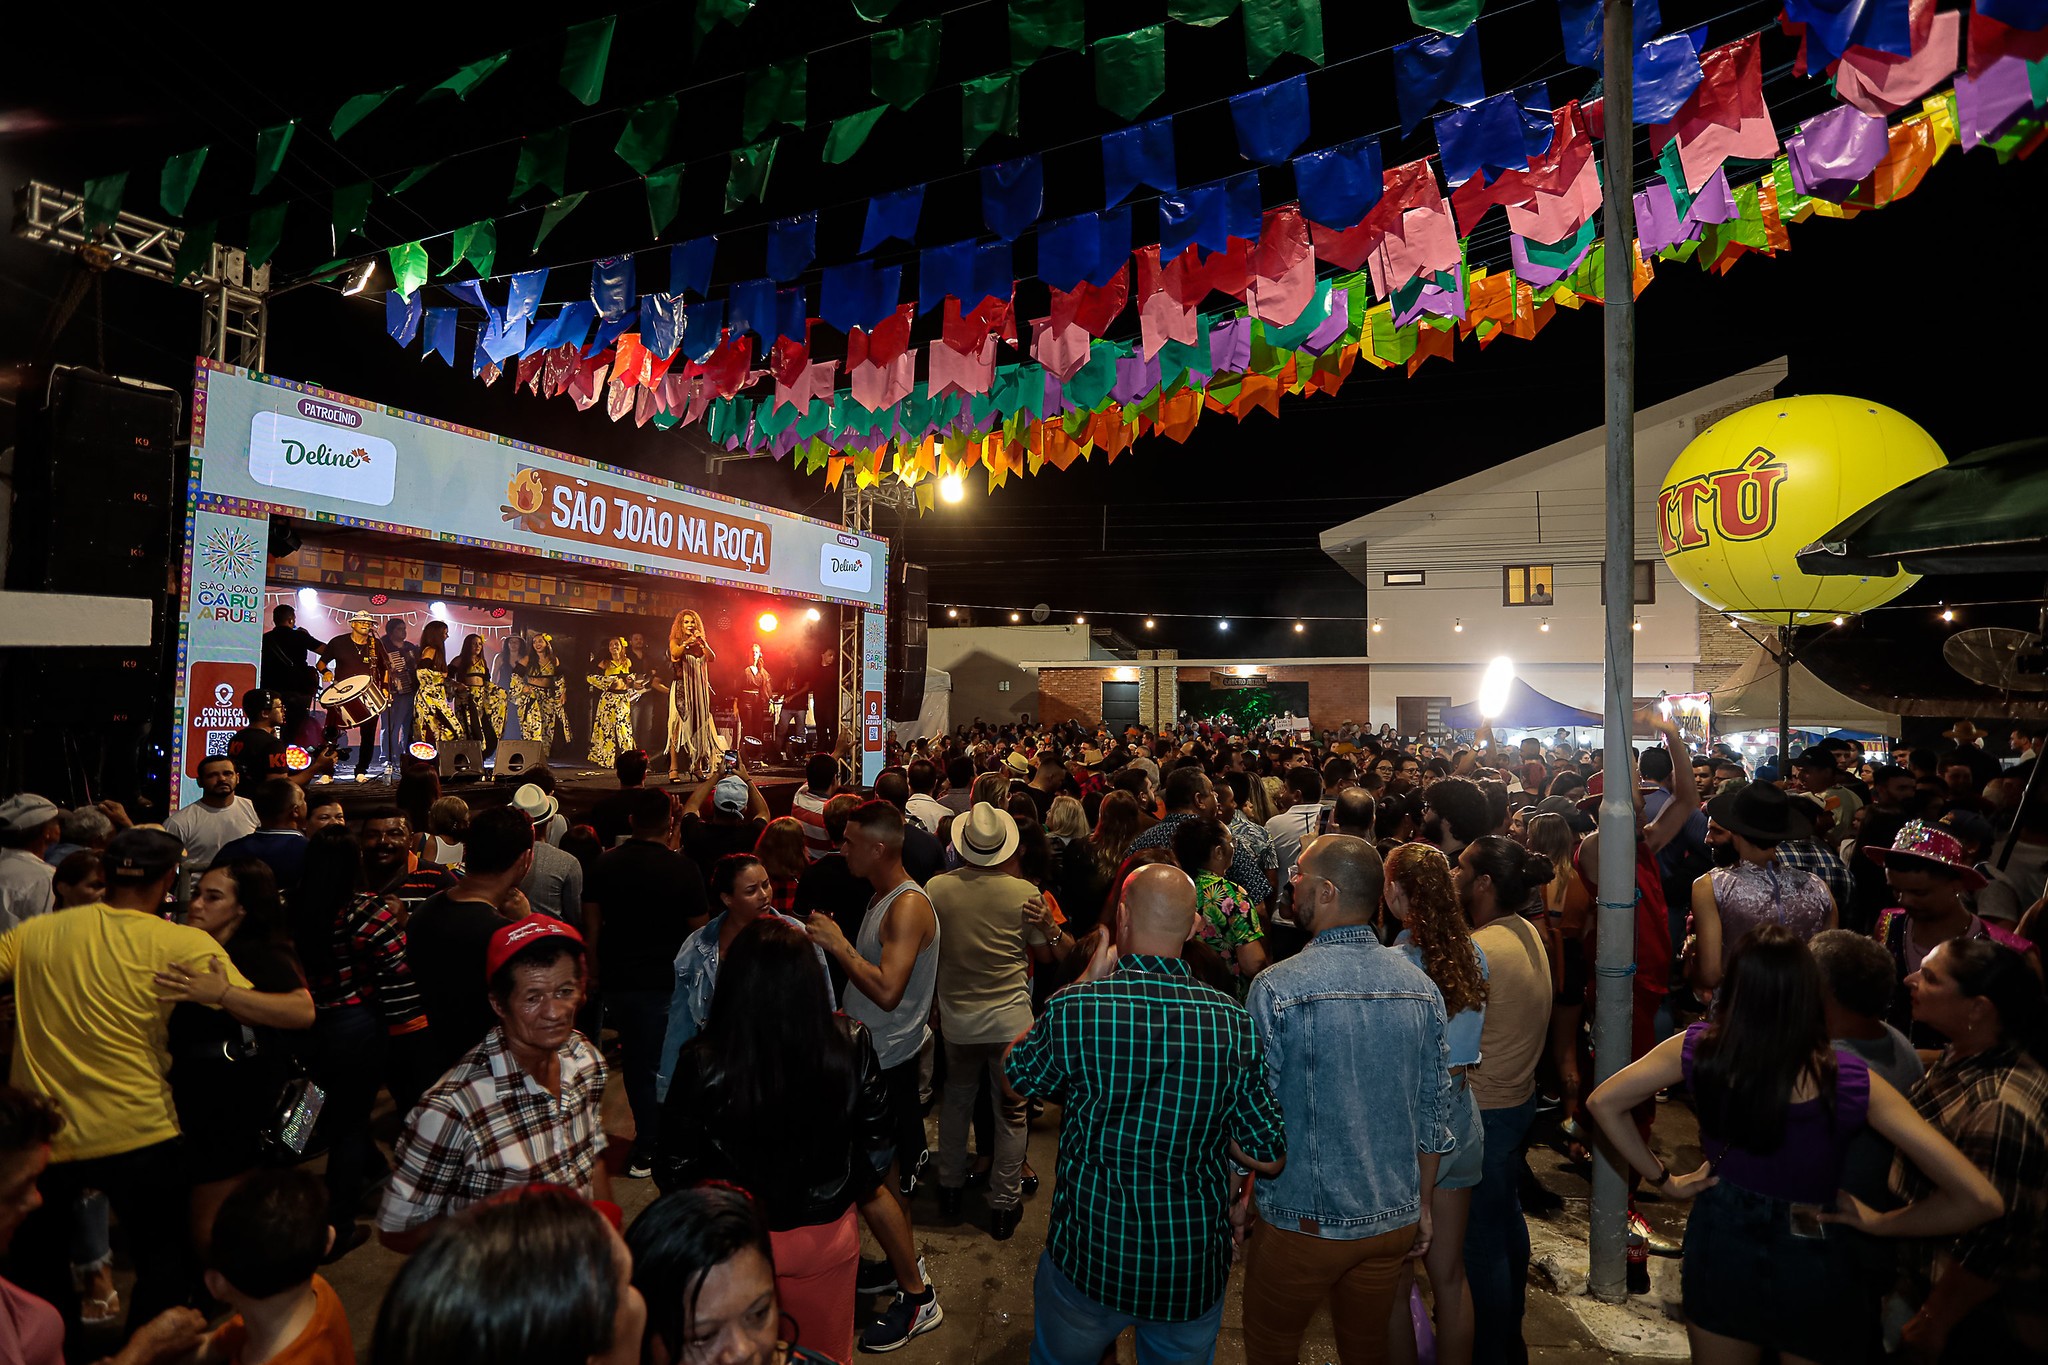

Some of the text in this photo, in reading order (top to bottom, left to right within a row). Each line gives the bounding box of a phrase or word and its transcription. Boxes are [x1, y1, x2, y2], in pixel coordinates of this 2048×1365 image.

[304, 402, 356, 426] PATROCÍNIO
[135, 437, 149, 446] K9
[281, 439, 361, 468] Deline
[133, 492, 148, 501] K9
[1657, 446, 1787, 557] ITÚ
[551, 479, 766, 571] SÃO JOÃO NA ROÇA
[831, 558, 860, 573] Deline
[199, 581, 258, 595] SÃO JOÃO
[198, 591, 258, 609] CARU
[197, 606, 243, 623] ARU
[123, 660, 137, 668] K9
[202, 707, 244, 718] CONHEÇA
[194, 716, 250, 727] CARUARU
